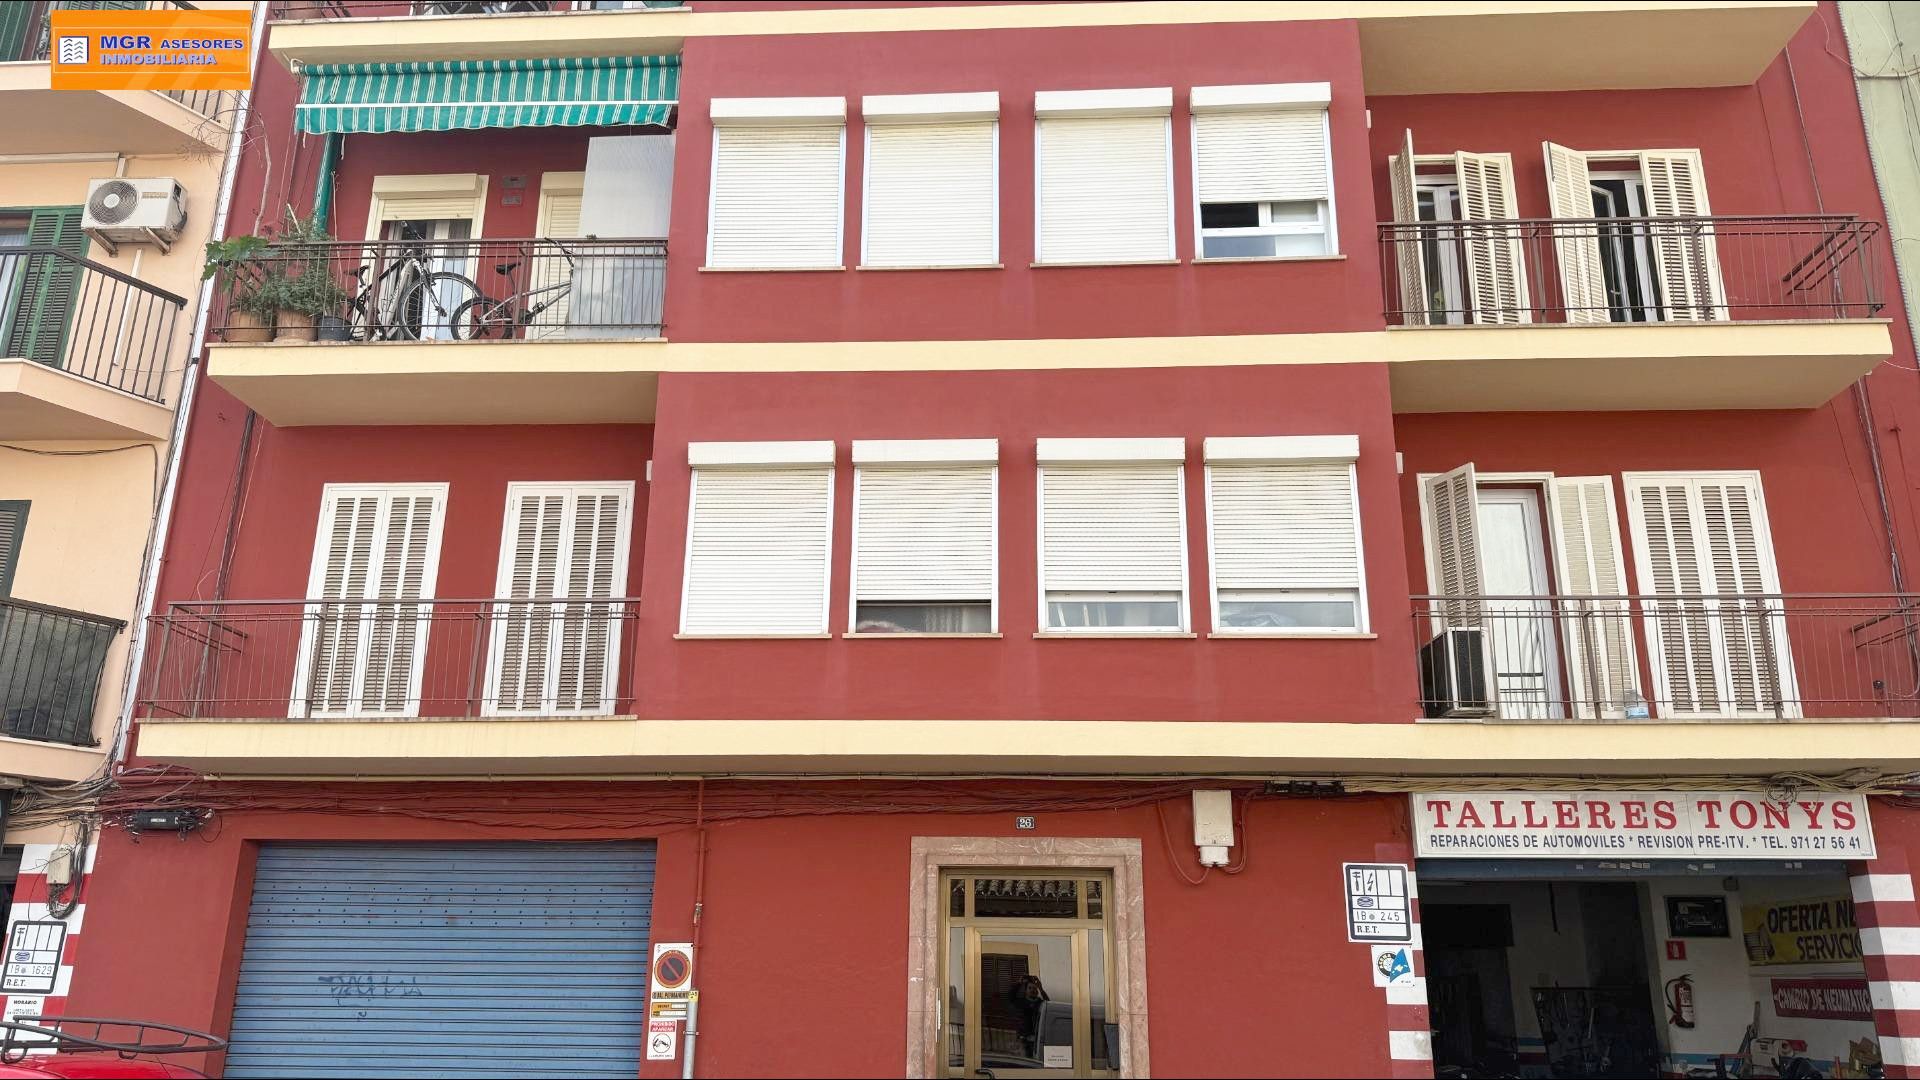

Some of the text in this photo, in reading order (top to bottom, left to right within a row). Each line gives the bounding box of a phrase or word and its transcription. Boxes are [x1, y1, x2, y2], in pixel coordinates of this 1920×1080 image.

[1427, 800, 1856, 830] TALLERES TONYS
[1019, 818, 1032, 828] 26
[1431, 834, 1519, 848] REPARACIONES
[1523, 834, 1538, 848] DE
[1543, 834, 1625, 848] AUTOMOVILES
[1638, 835, 1693, 849] REVISION
[1698, 835, 1749, 849] PRE-ITV.
[1761, 836, 1787, 849] TEL.
[1792, 836, 1809, 849] 971
[1813, 836, 1826, 849] 27
[1831, 836, 1845, 849] 56
[1849, 836, 1861, 849] 41
[1381, 911, 1400, 921] 245
[1767, 902, 1832, 933] OFERTA
[32, 966, 53, 975] 1629
